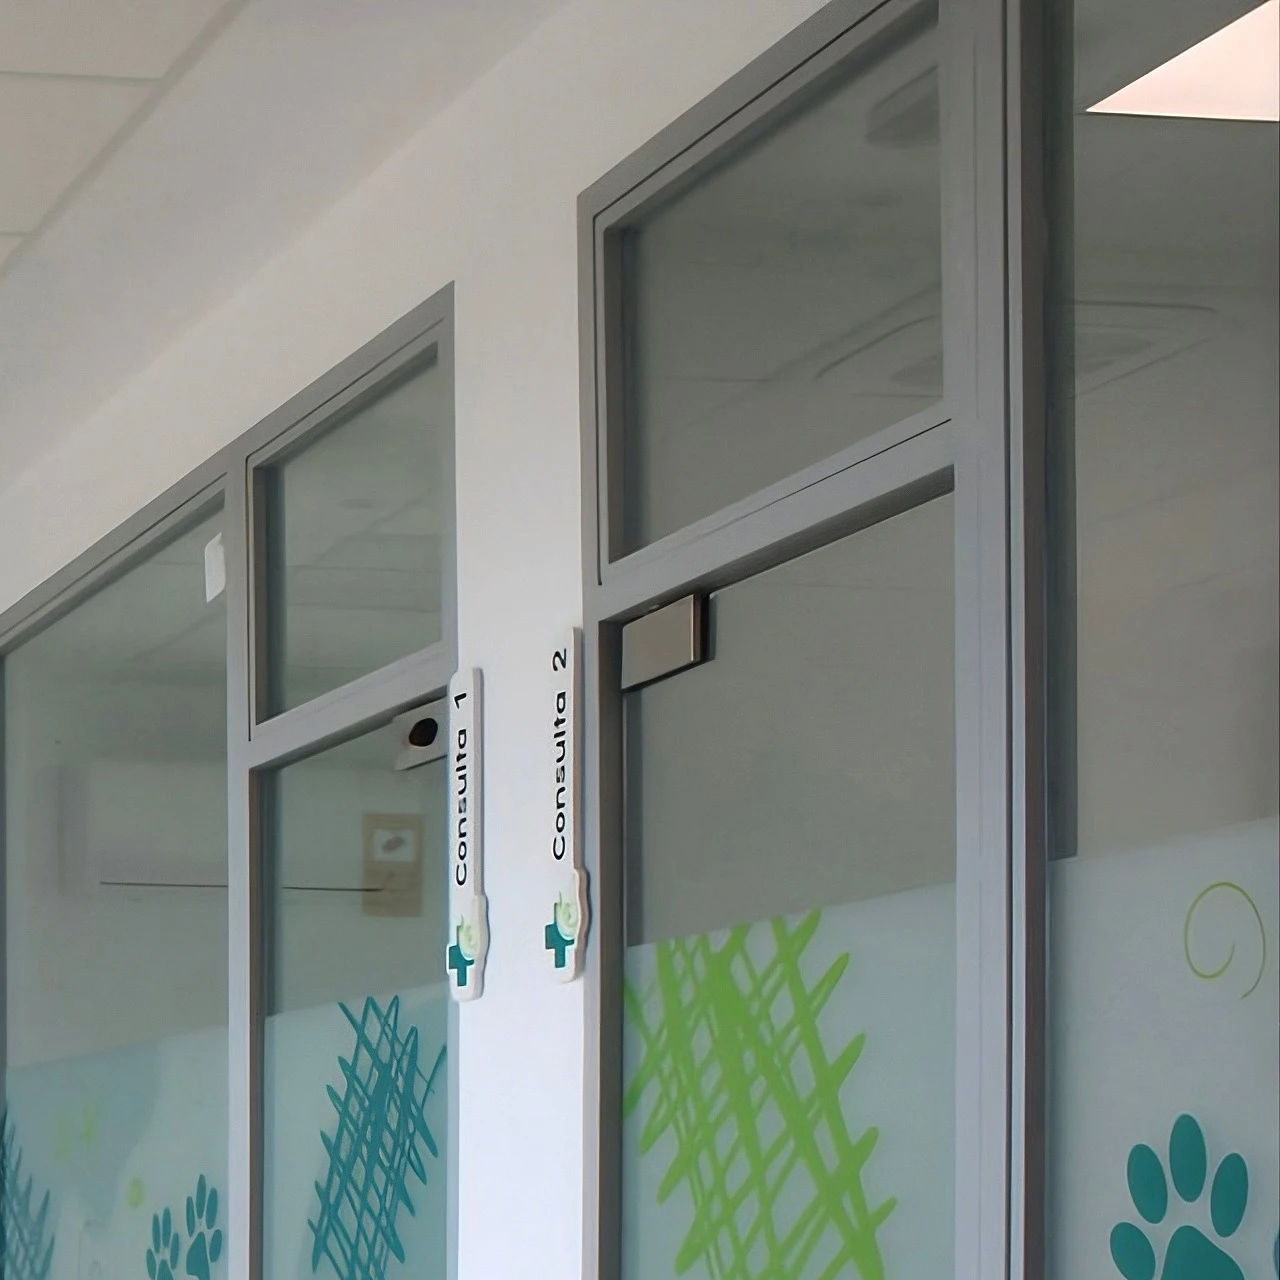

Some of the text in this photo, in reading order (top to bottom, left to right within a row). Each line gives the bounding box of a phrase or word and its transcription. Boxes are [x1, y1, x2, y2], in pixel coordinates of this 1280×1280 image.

[454, 692, 468, 887] Consulta 1
[552, 648, 567, 861] Consulta 2
